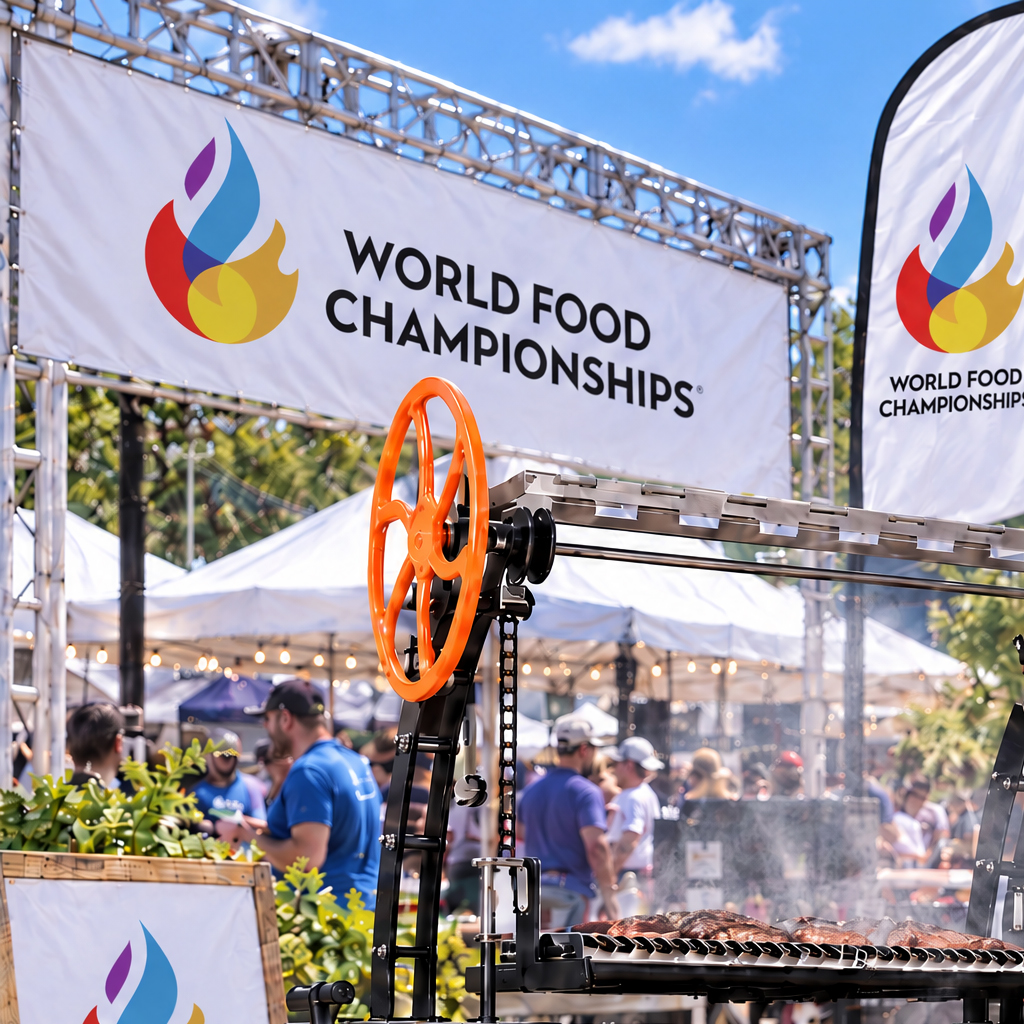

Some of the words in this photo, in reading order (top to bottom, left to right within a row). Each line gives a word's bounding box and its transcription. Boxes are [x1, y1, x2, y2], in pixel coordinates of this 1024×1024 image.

[343, 229, 520, 315] WORLD
[532, 283, 651, 352] FOOD
[889, 371, 962, 393] WORLD
[967, 368, 1023, 388] FOOD
